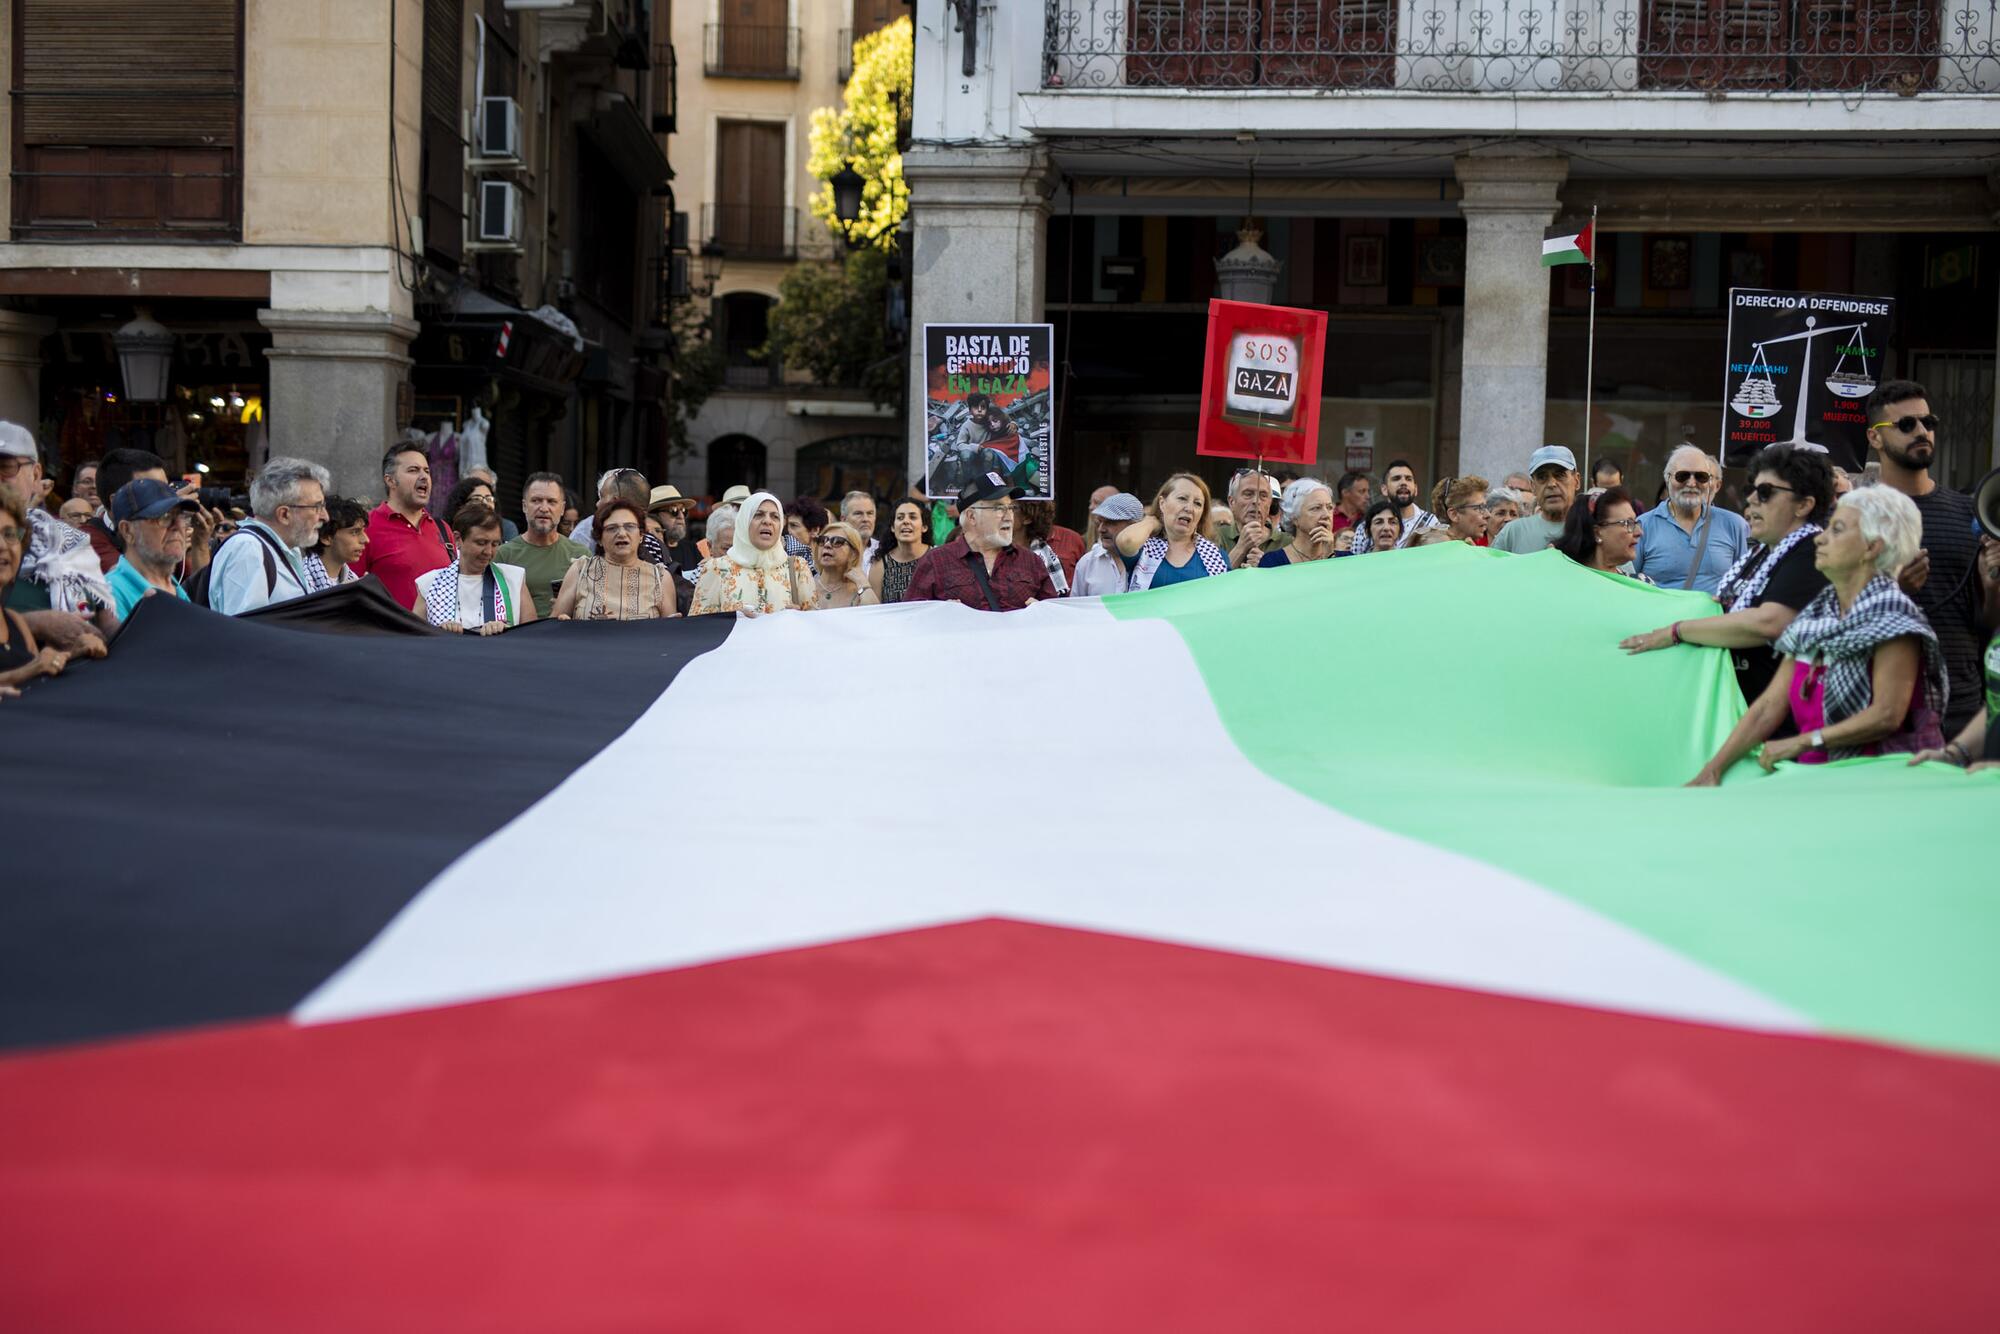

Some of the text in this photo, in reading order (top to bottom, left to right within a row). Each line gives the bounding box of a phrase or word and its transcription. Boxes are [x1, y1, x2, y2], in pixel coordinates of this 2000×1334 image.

[1735, 295, 1889, 315] DERECHO A DEFENDERSE
[945, 335, 1030, 356] BASTA DE
[1244, 341, 1288, 363] SOS
[1835, 345, 1877, 358] HAMAS
[946, 356, 1030, 375] GENOCIDIO
[1730, 363, 1788, 375] NETANYAHU
[948, 375, 1029, 395] EN GAZA
[1237, 371, 1289, 396] GAZA
[1739, 420, 1771, 429] 39.000
[1823, 412, 1866, 423] MUERTOS
[1731, 432, 1776, 442] MUERTOS
[1039, 422, 1048, 493] #FREEPALESTINE
